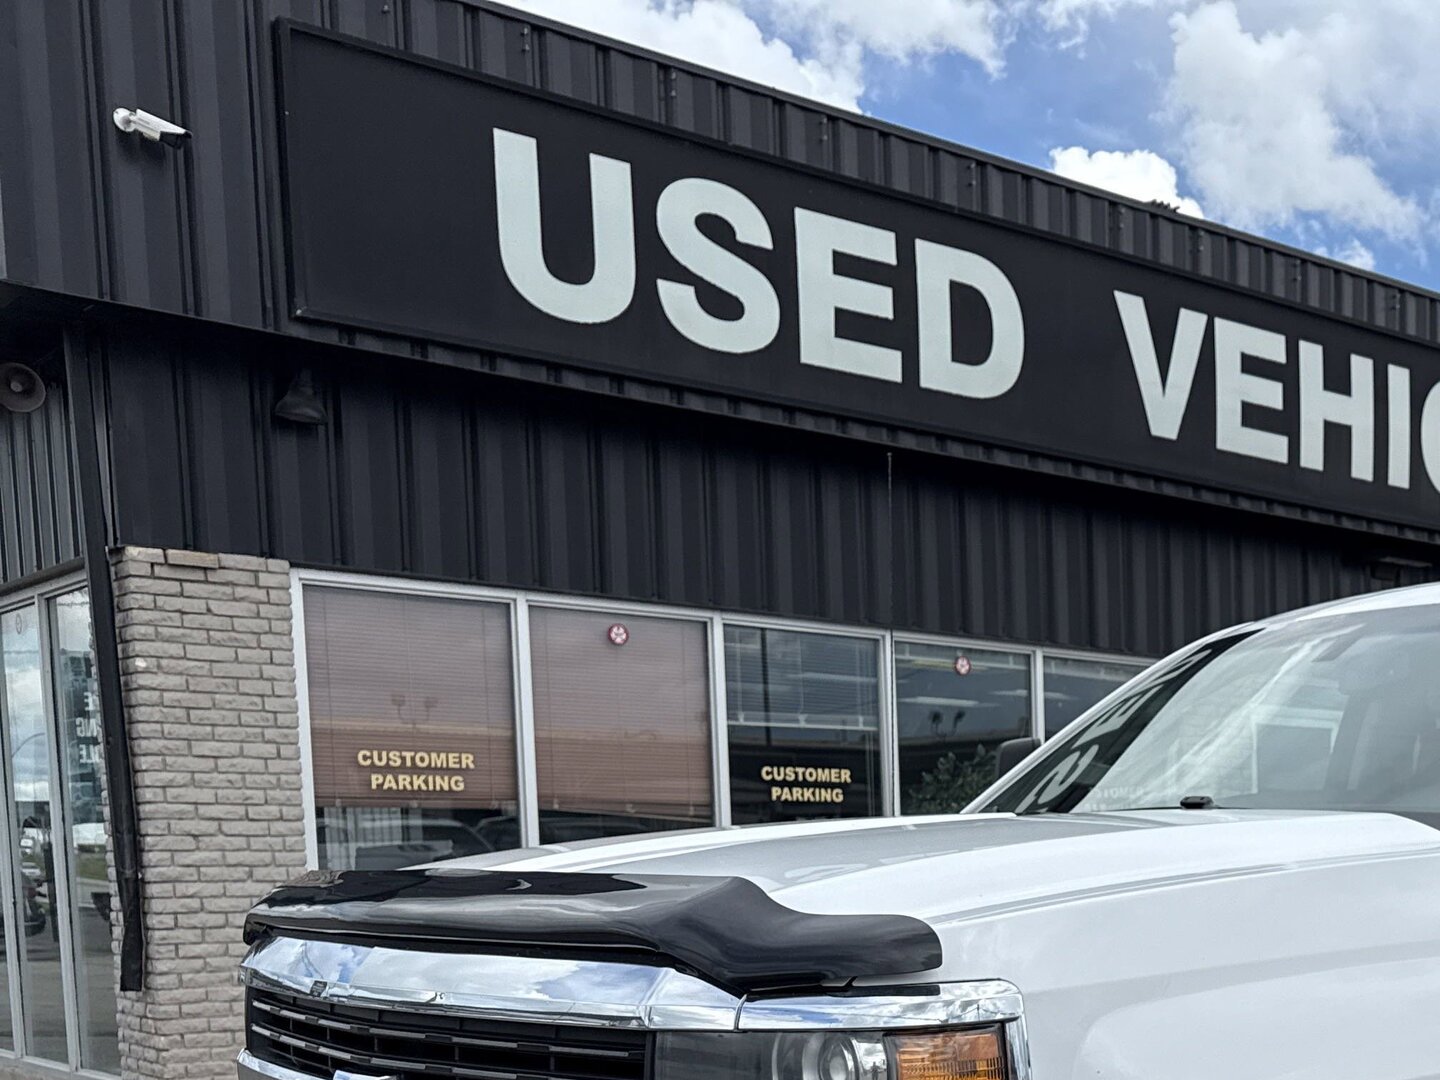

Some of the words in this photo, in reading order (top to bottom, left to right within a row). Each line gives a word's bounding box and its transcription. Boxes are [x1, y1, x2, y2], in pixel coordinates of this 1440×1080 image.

[493, 128, 1024, 398] USED
[357, 750, 475, 769] CUSTOMER
[370, 773, 465, 791] PARKING
[761, 765, 852, 783] CUSTOMER
[771, 786, 844, 803] PARKING
